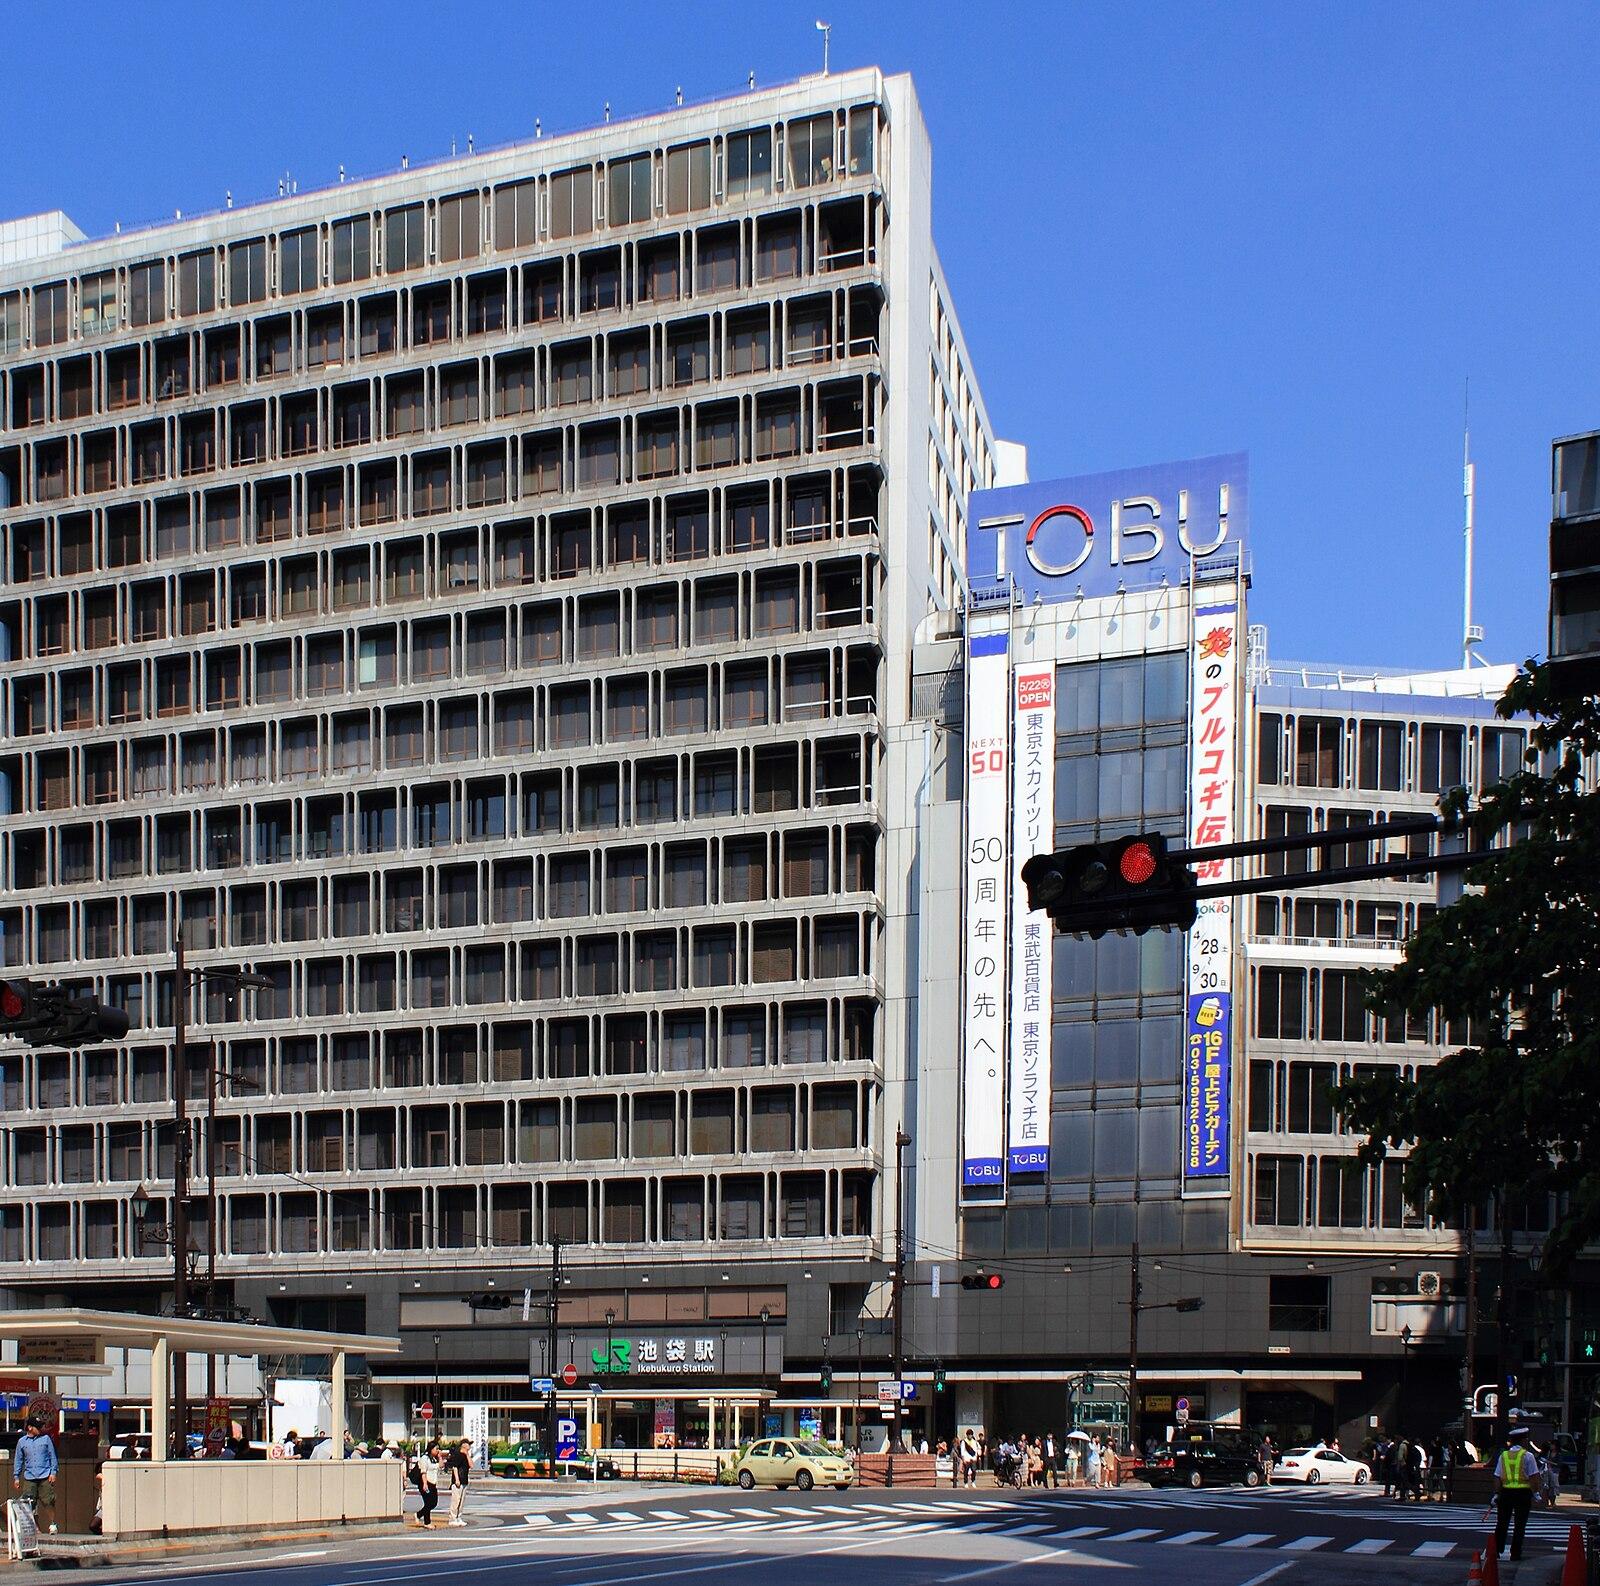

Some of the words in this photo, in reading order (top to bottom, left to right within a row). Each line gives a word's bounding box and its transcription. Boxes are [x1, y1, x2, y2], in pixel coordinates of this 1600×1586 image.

[978, 483, 1229, 580] TOBU
[1019, 692, 1050, 704] OPEN
[971, 738, 1003, 749] NEXT
[972, 750, 1003, 774] 50
[970, 837, 1003, 1079] 50周年の先へ。
[1024, 923, 1040, 1012] 東武百貨店
[1021, 1021, 1039, 1139] 東京ソラマチ店
[1012, 1153, 1046, 1165] TOBU
[967, 1165, 1000, 1177] TOBU
[592, 1339, 632, 1364] JR
[638, 1340, 714, 1361] 池袋駅
[638, 1364, 679, 1373] Ikebukuro
[682, 1364, 715, 1373] Station
[902, 1383, 914, 1398] P
[558, 1419, 577, 1443] P
